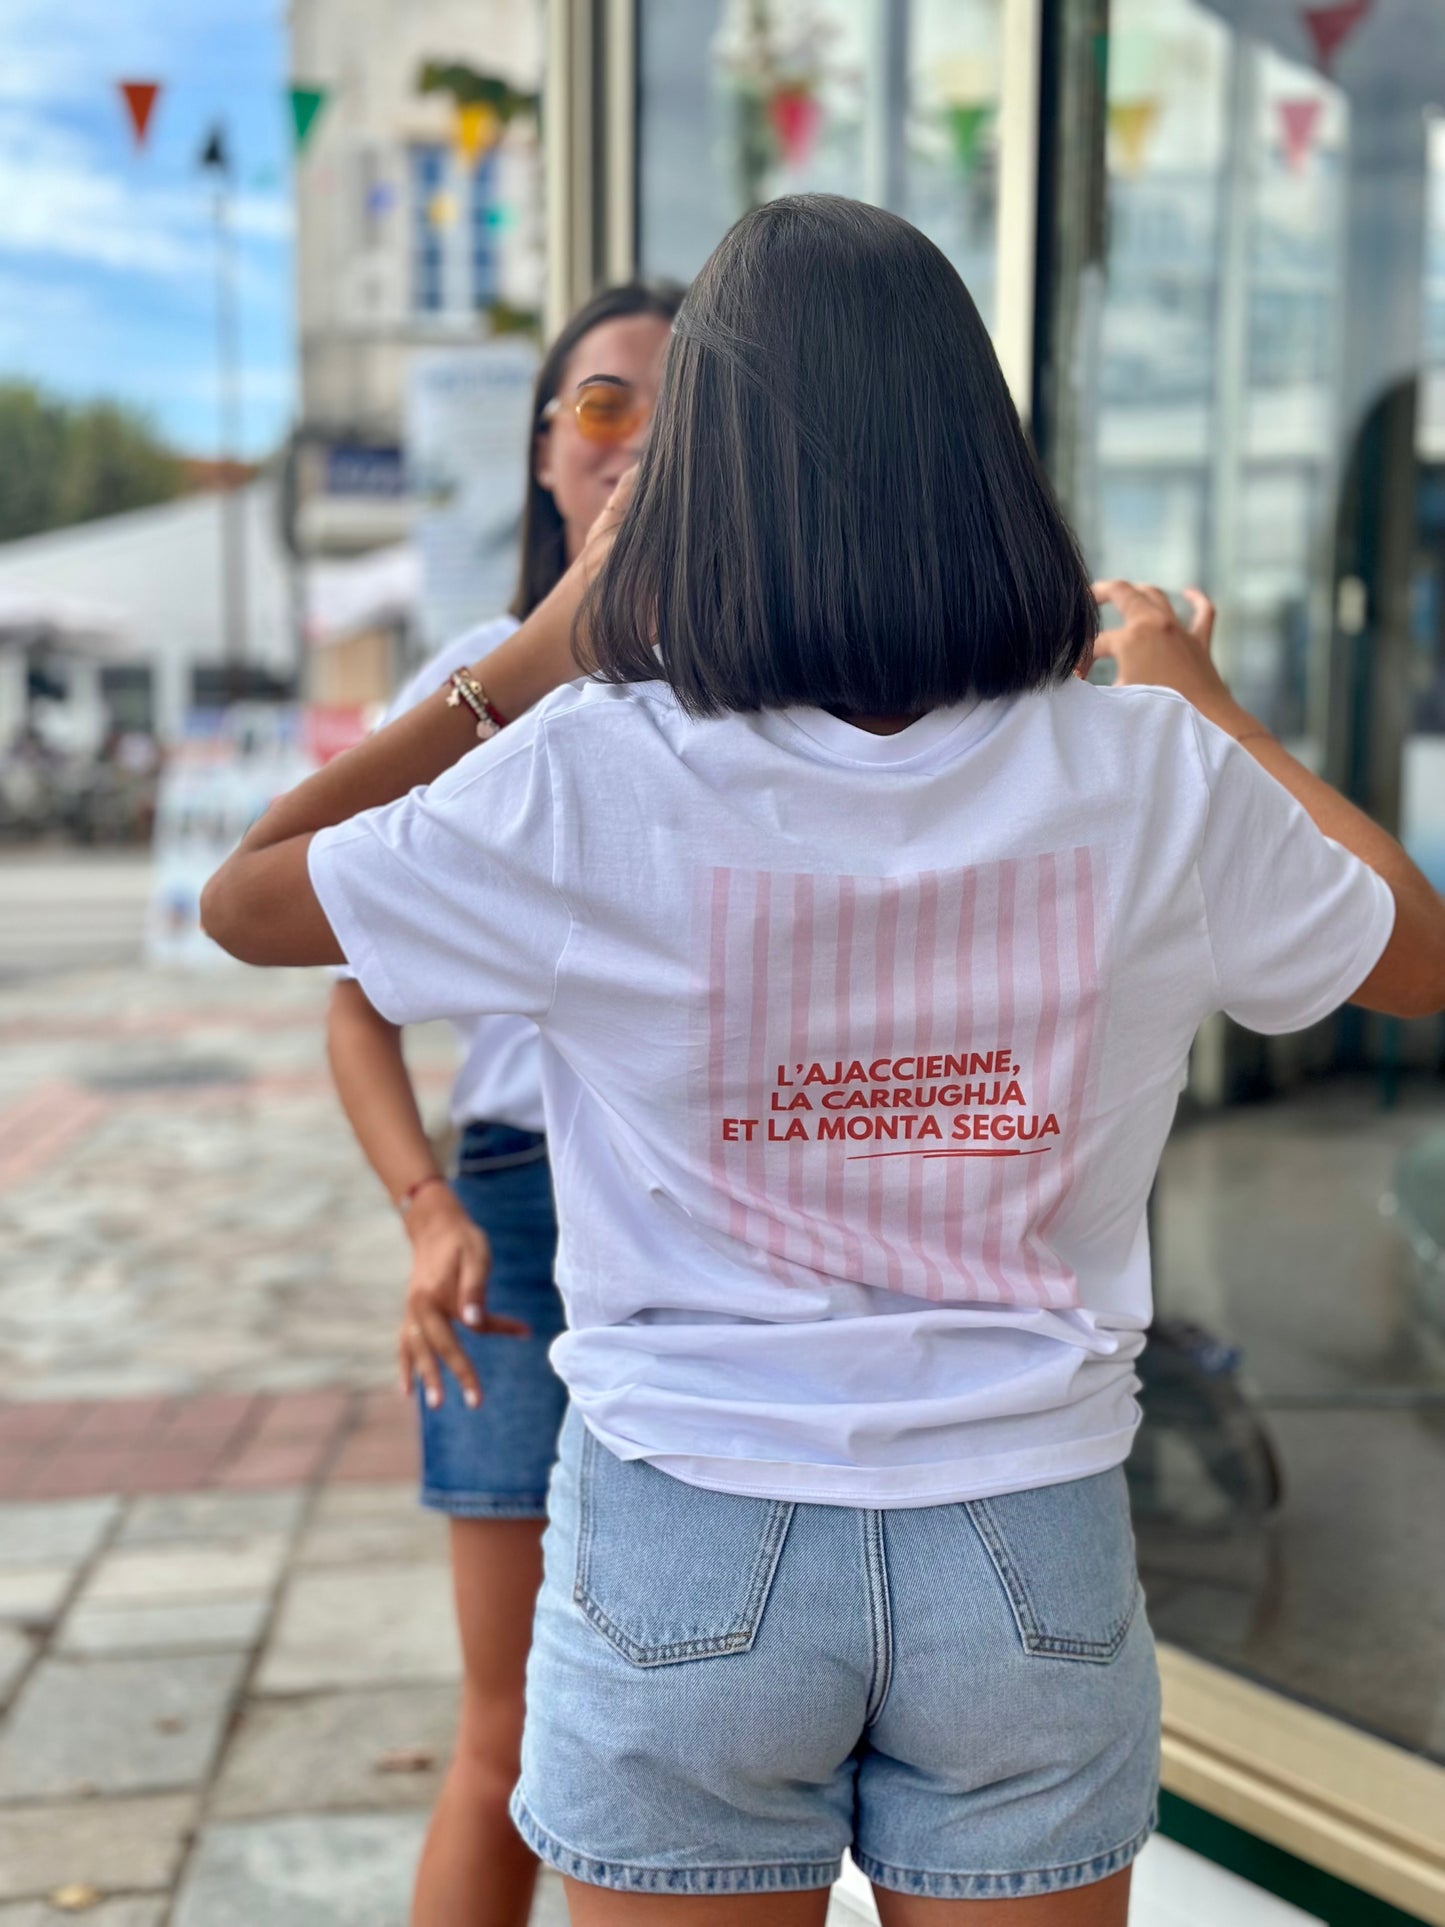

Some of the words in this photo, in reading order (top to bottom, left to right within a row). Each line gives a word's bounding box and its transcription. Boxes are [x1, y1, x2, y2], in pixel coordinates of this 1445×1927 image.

[777, 1048, 1021, 1087] L'AJACCIENNE,
[770, 1091, 813, 1112] LA
[821, 1080, 1026, 1110] CARRUGHJA
[722, 1118, 759, 1142] ET
[767, 1117, 810, 1142] LA
[816, 1114, 943, 1141] MONTA
[950, 1113, 1061, 1142] SEGUA
